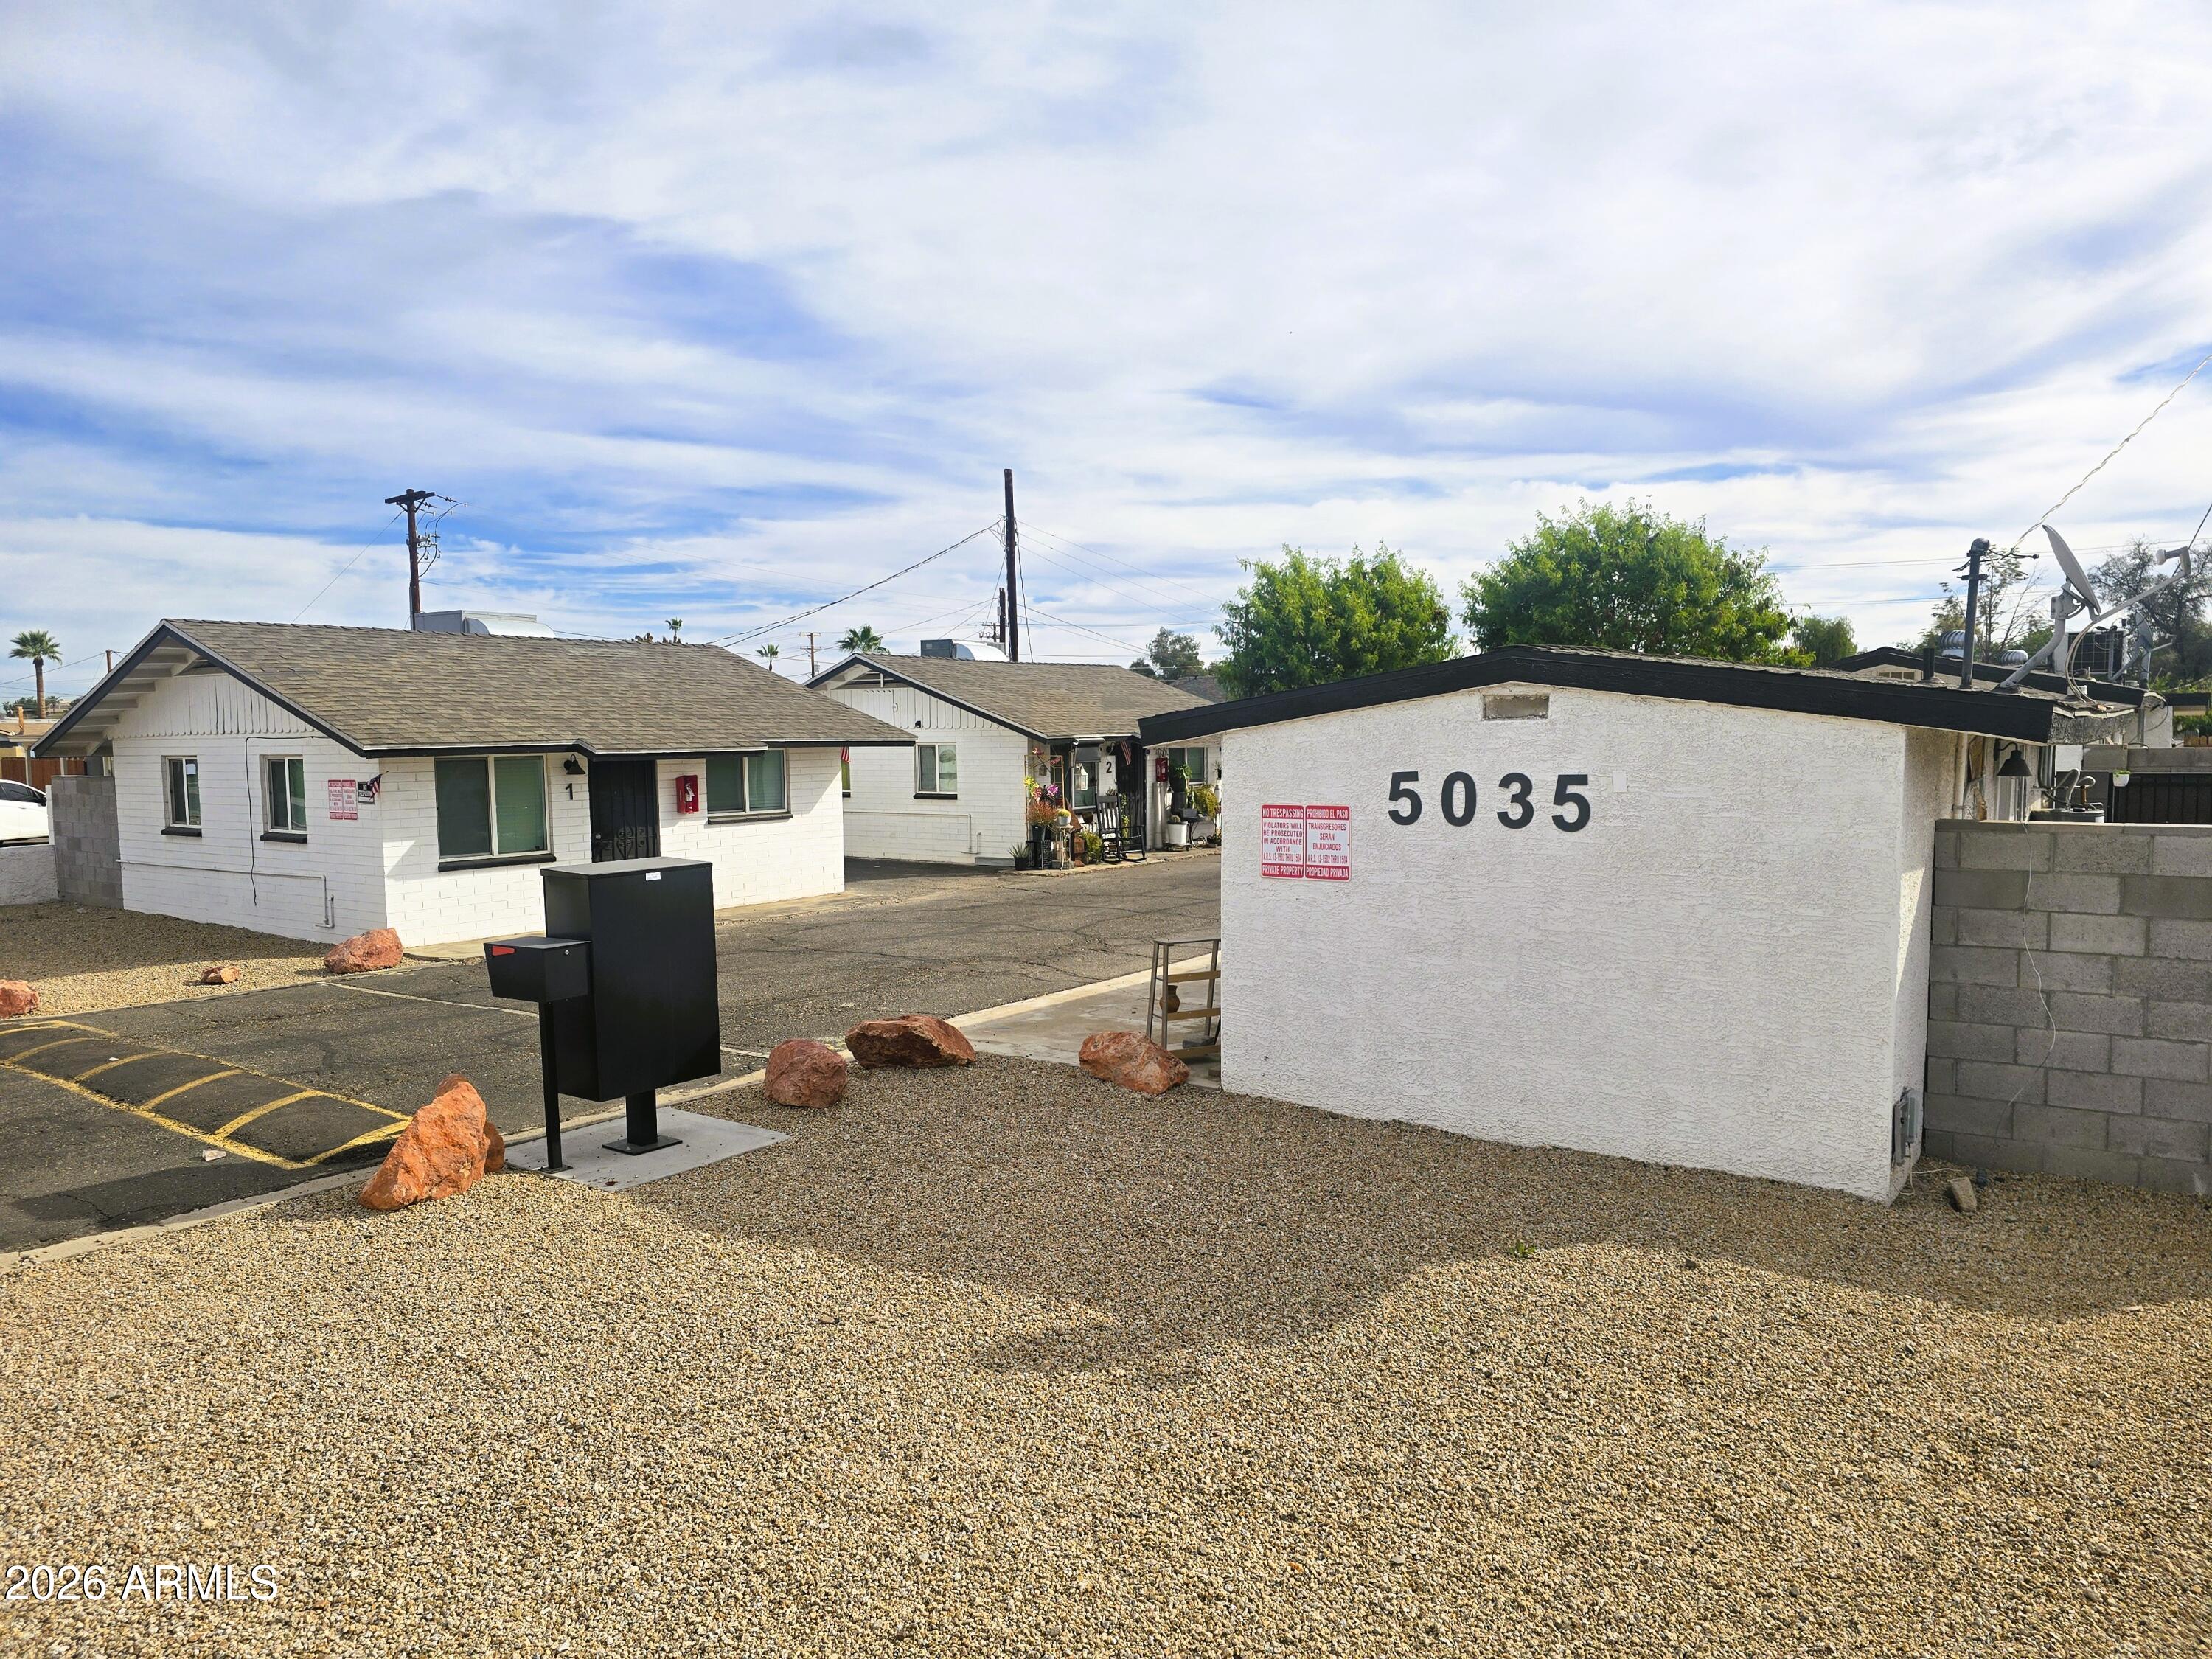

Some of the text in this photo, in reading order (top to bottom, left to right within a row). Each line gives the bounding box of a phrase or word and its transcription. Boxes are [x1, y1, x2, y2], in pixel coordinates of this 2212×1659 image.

[1106, 761, 1112, 773] 2
[566, 782, 574, 800] 1
[1388, 771, 1591, 832] 5035
[1262, 807, 1304, 818] NO TRESPASSING
[1307, 808, 1348, 819] PROHIBIDO EL PASO
[1308, 822, 1346, 831] TRANSGRESORES
[1271, 830, 1303, 838] PROSECUTED
[1320, 832, 1335, 841] SERAN
[1262, 864, 1304, 876] PRIVATE PROPERTY
[1329, 868, 1349, 878] PRIVADA
